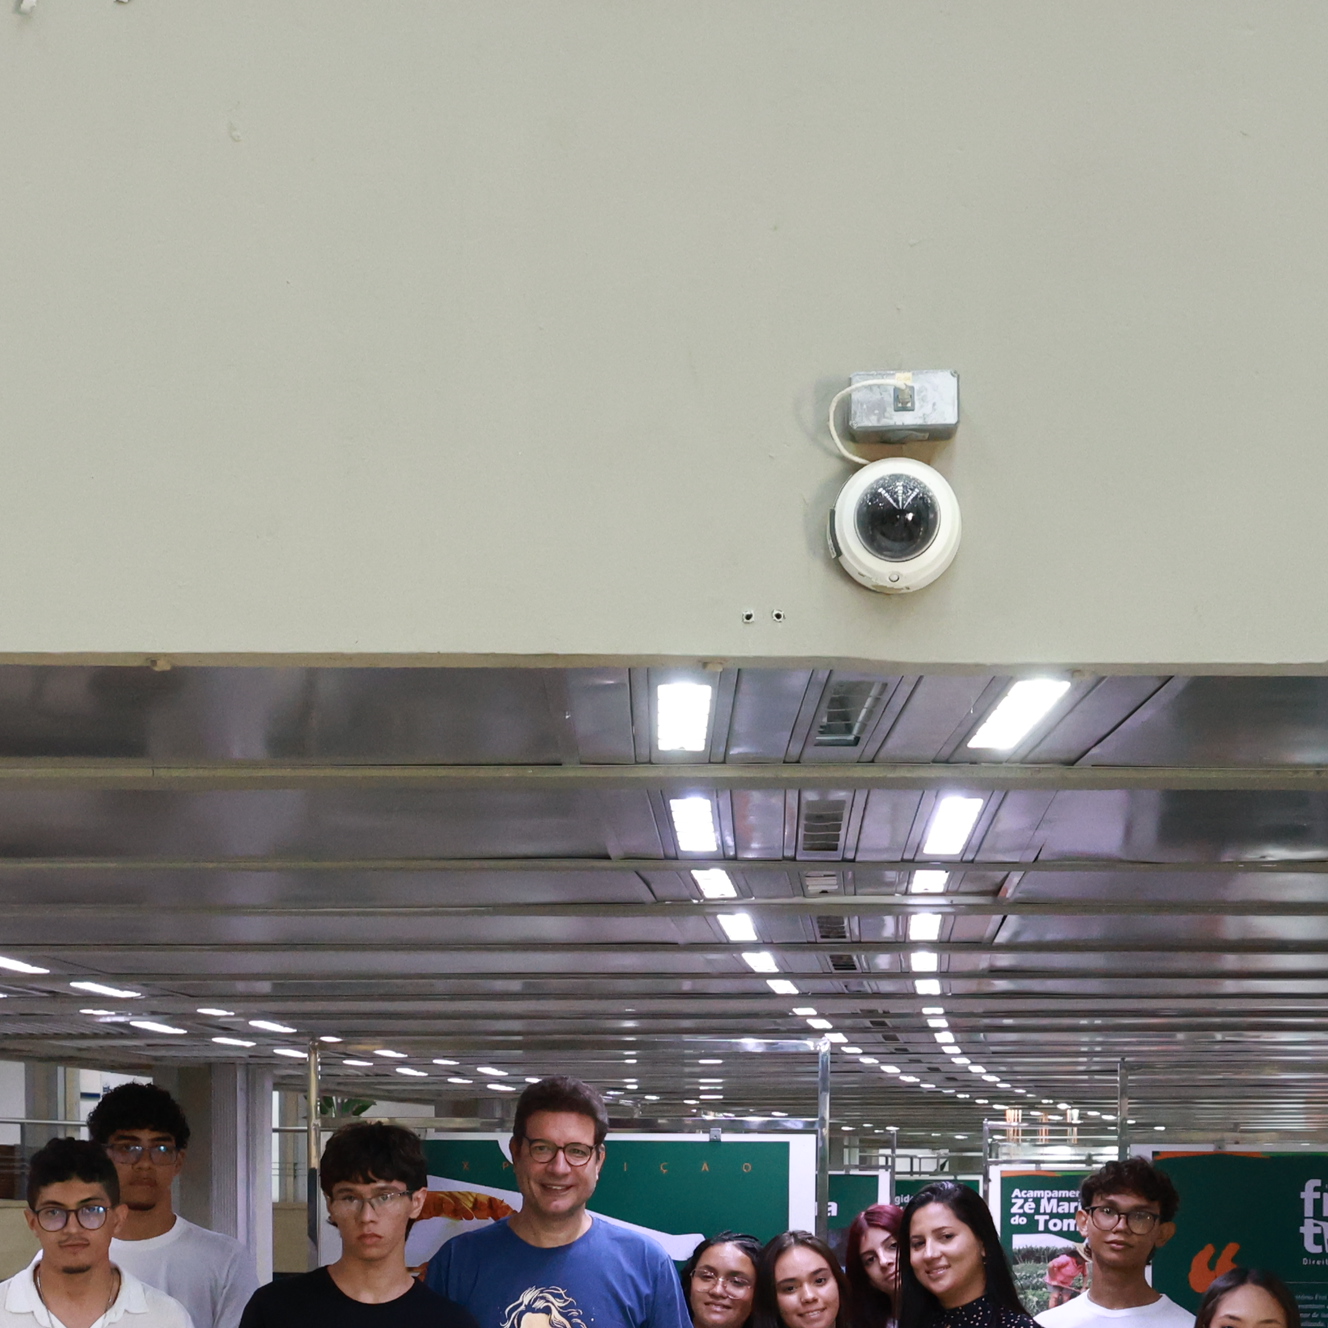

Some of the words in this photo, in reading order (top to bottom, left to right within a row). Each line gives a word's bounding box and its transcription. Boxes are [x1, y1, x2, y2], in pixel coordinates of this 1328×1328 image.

[1010, 1199, 1036, 1213] Zé
[1039, 1198, 1082, 1213] Mari
[1010, 1215, 1027, 1225] do
[1034, 1214, 1080, 1231] Tom
